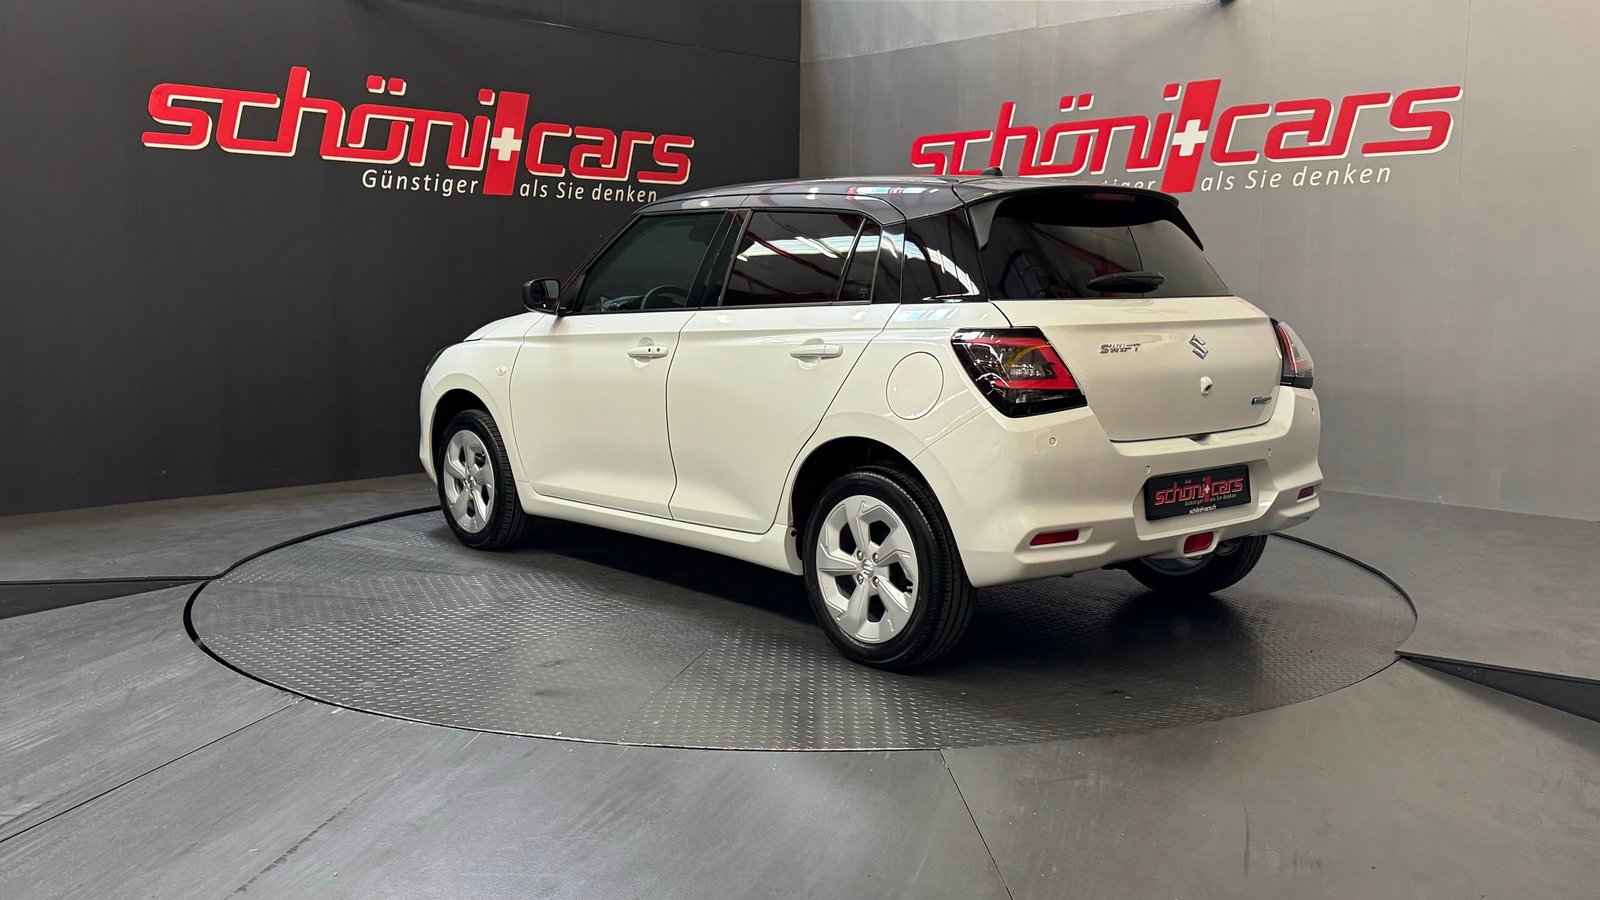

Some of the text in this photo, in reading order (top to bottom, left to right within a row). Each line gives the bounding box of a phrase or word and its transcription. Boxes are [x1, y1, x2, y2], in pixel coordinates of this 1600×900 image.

[362, 169, 657, 203] Günstiger als Sie denken
[1200, 163, 1391, 192] als Sie denken
[1099, 343, 1141, 353] SWIFT
